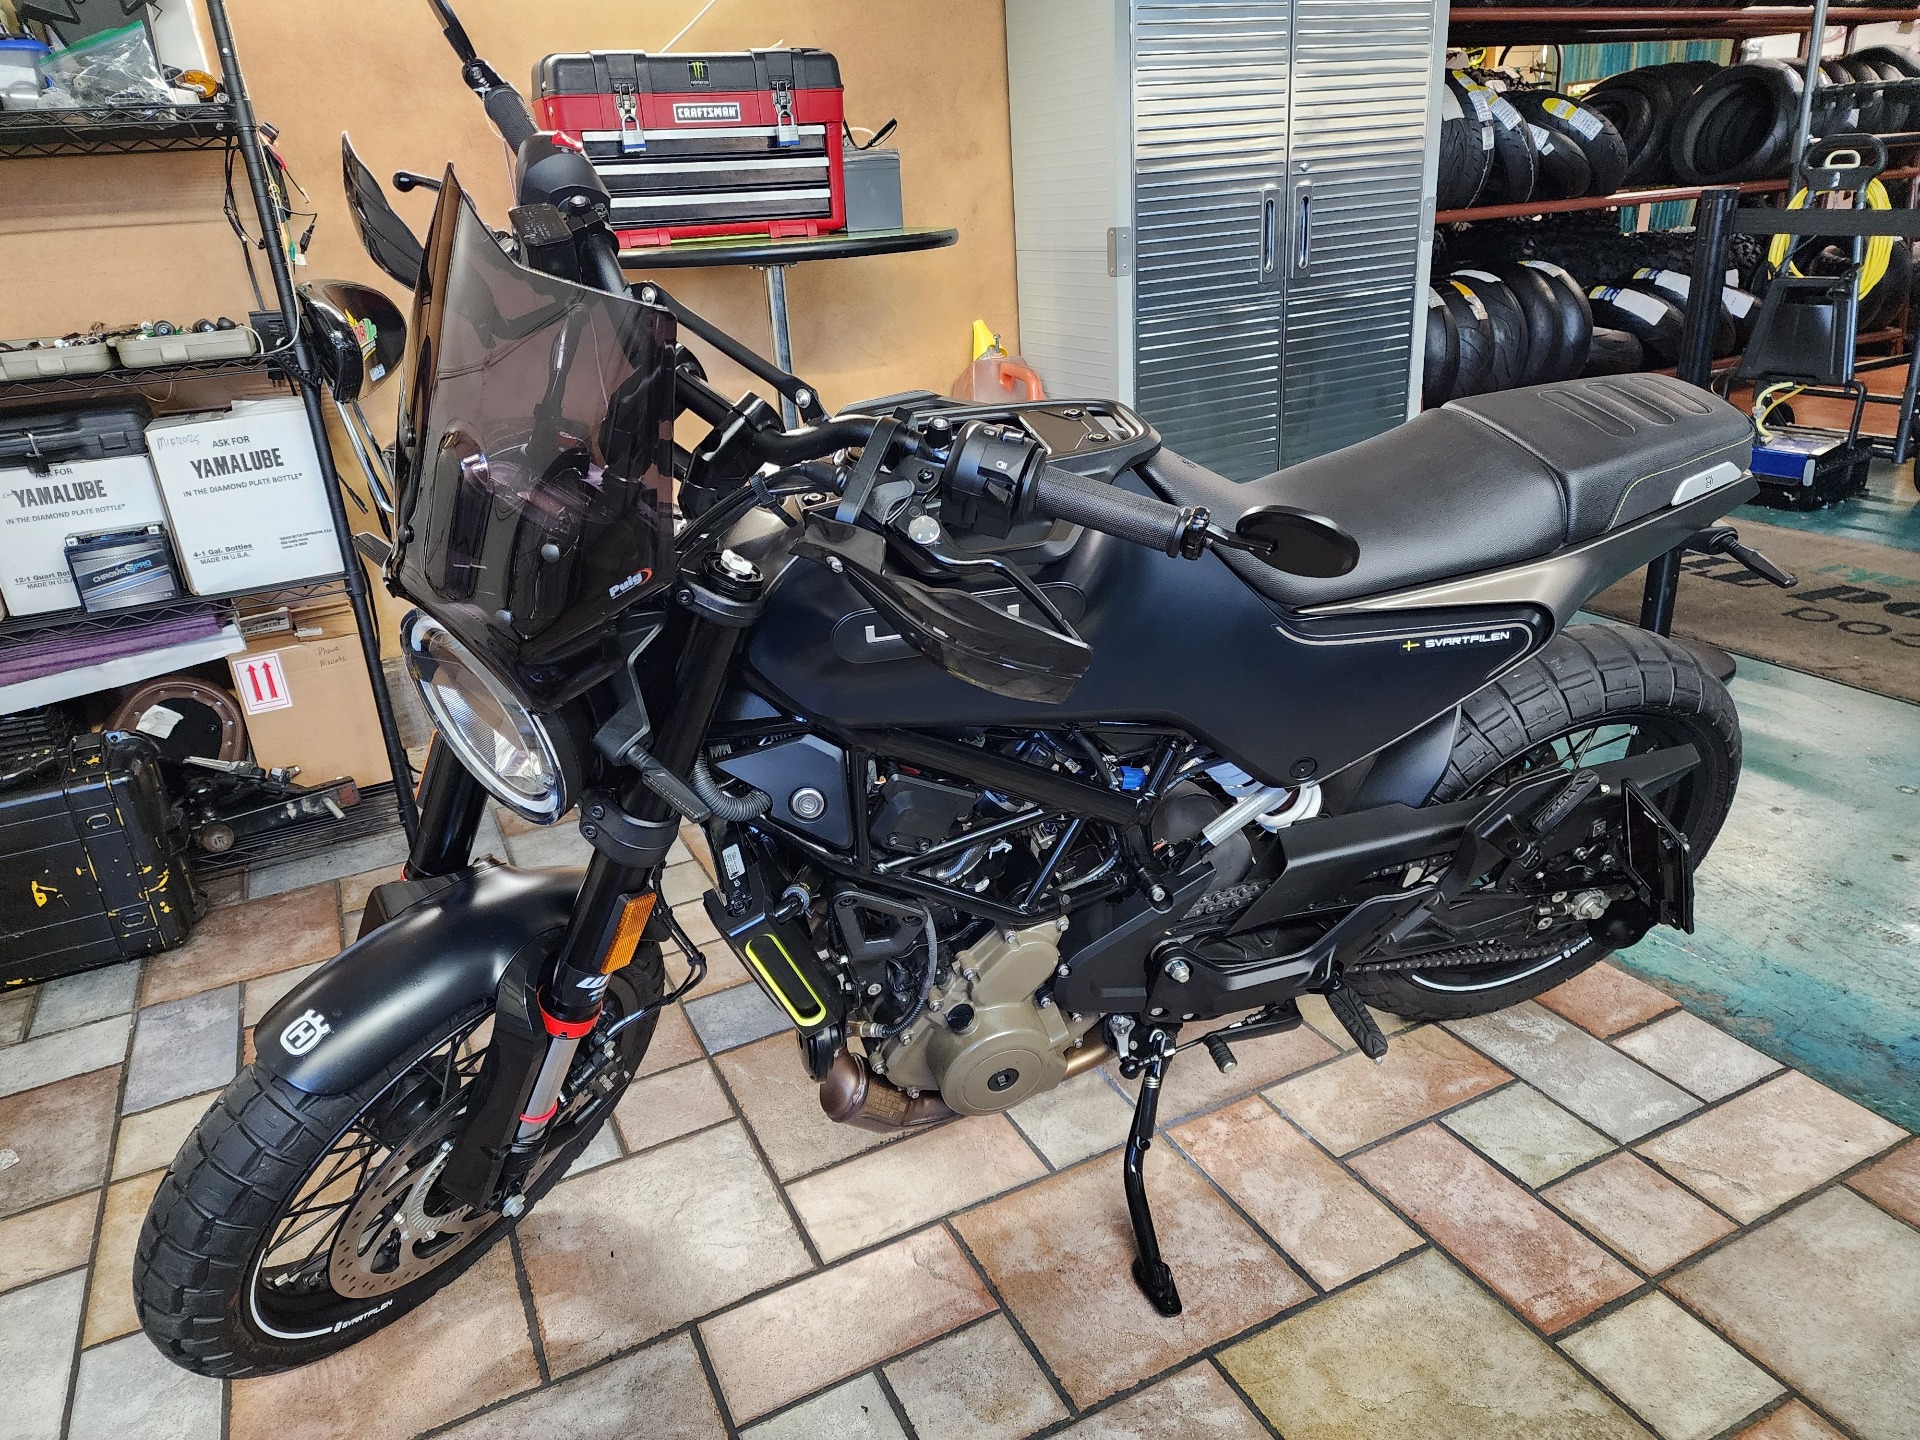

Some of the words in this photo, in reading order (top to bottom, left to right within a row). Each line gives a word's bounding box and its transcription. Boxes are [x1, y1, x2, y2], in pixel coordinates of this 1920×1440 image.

[212, 439, 231, 448] ASK
[231, 435, 250, 445] FOR
[189, 447, 285, 479] YAMALUBE
[54, 467, 73, 477] FOR
[13, 479, 107, 509] YAMALUBE
[193, 487, 209, 496] THE
[209, 481, 248, 494] DIAMOND
[248, 477, 272, 487] PLATE
[15, 516, 31, 524] THE
[32, 511, 70, 522] DIAMOND
[71, 508, 94, 516] PLATE
[193, 550, 206, 558] 4-1
[208, 546, 223, 556] Gal.
[225, 542, 253, 553] Bottles
[200, 556, 221, 565] MADE
[14, 576, 32, 584] 12-1
[33, 572, 55, 581] Quart
[26, 581, 47, 590] MADE
[608, 572, 643, 598] Puig
[1425, 631, 1510, 648] SVARTPILEN
